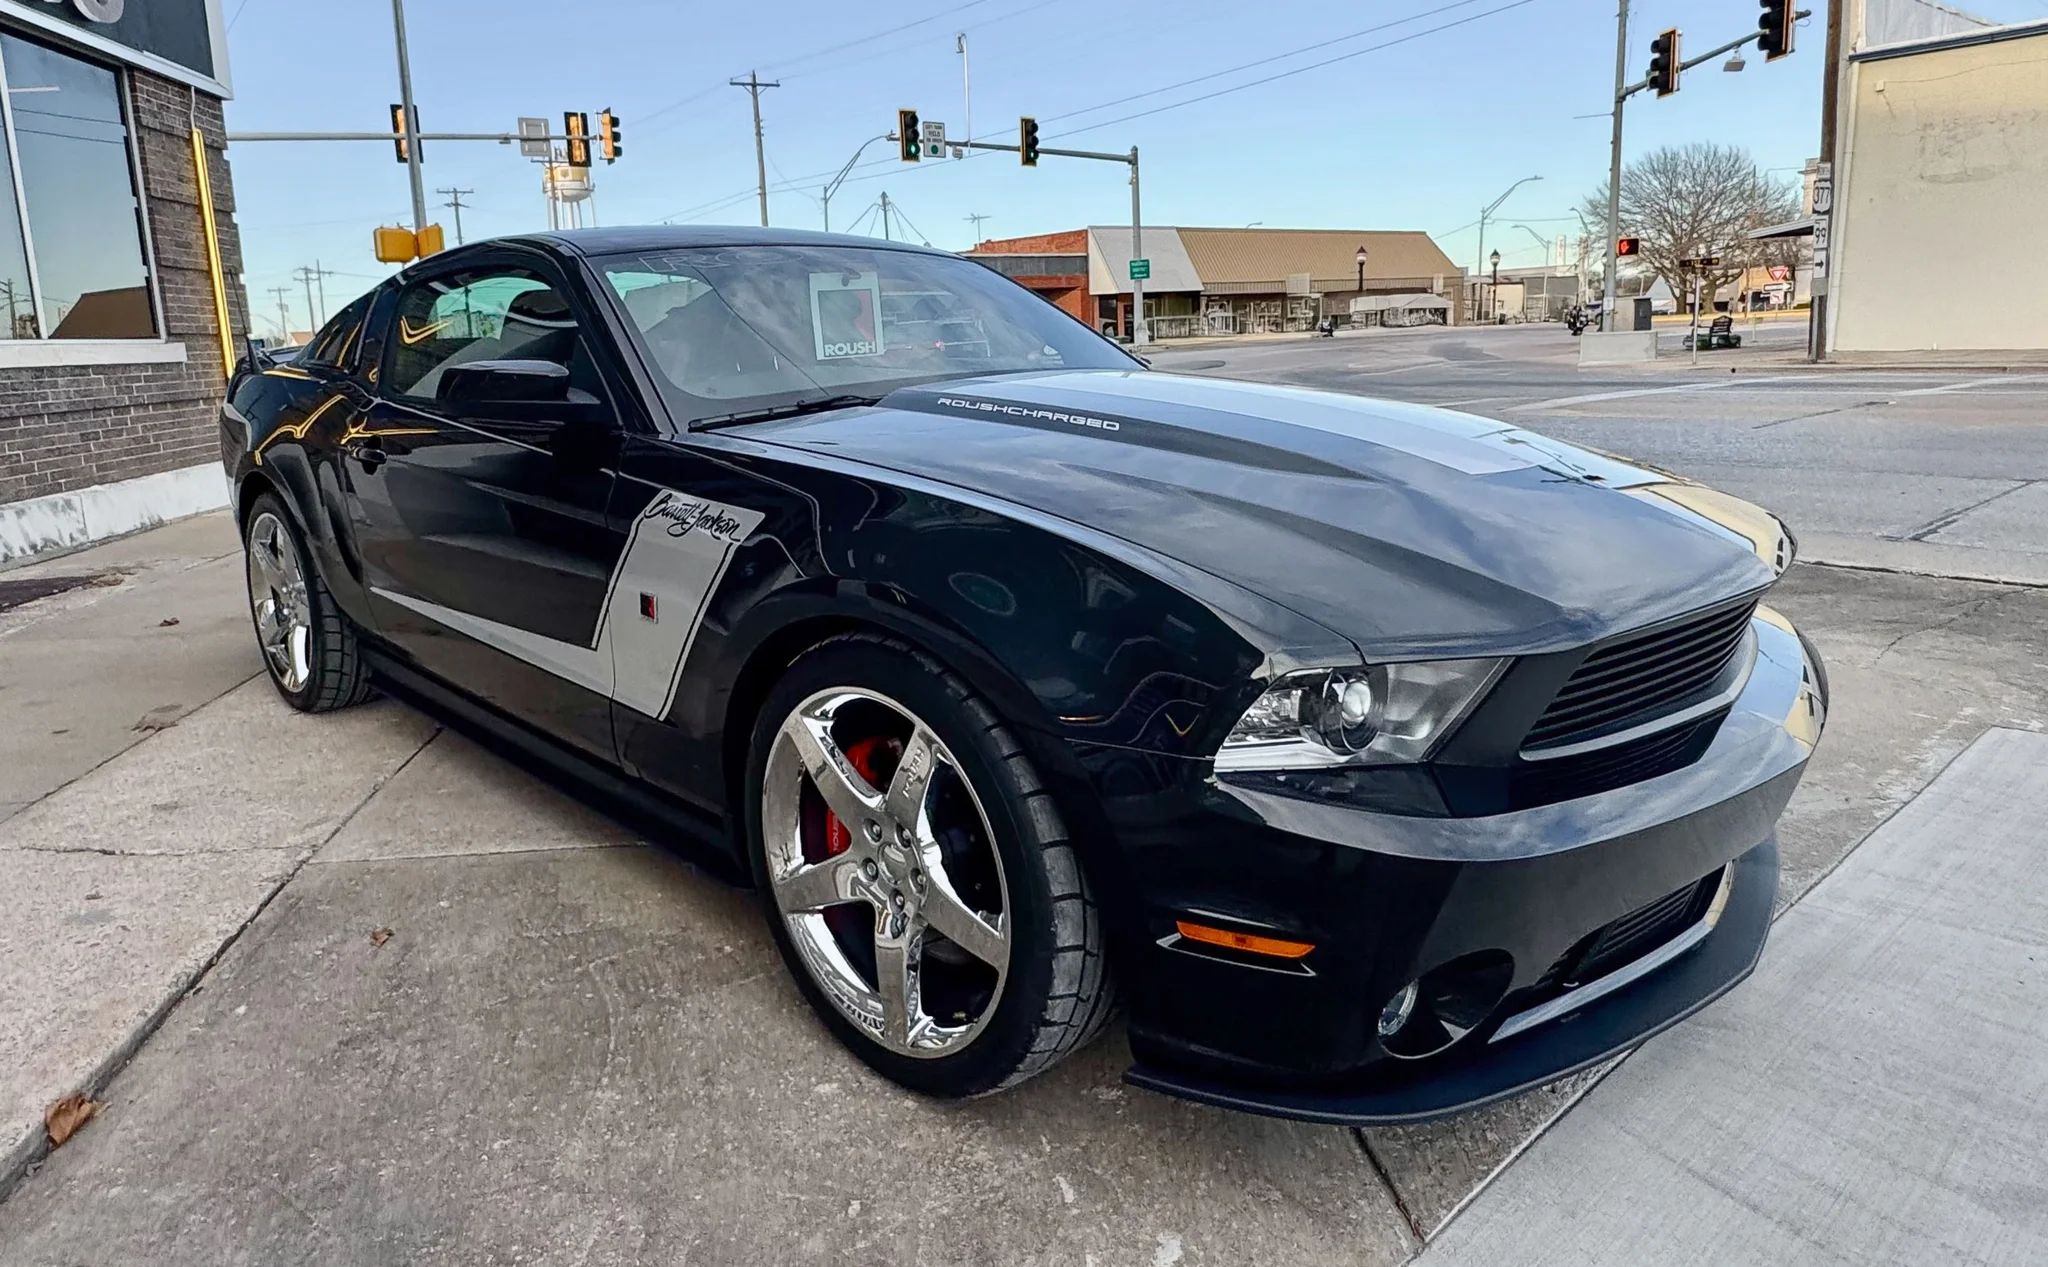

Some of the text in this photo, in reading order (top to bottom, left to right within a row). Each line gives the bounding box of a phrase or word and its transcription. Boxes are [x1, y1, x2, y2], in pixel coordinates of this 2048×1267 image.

[1812, 186, 1831, 204] 377
[1814, 227, 1827, 244] 99
[824, 341, 877, 357] ROUSH
[937, 397, 1120, 431] ROUSHCHARGED
